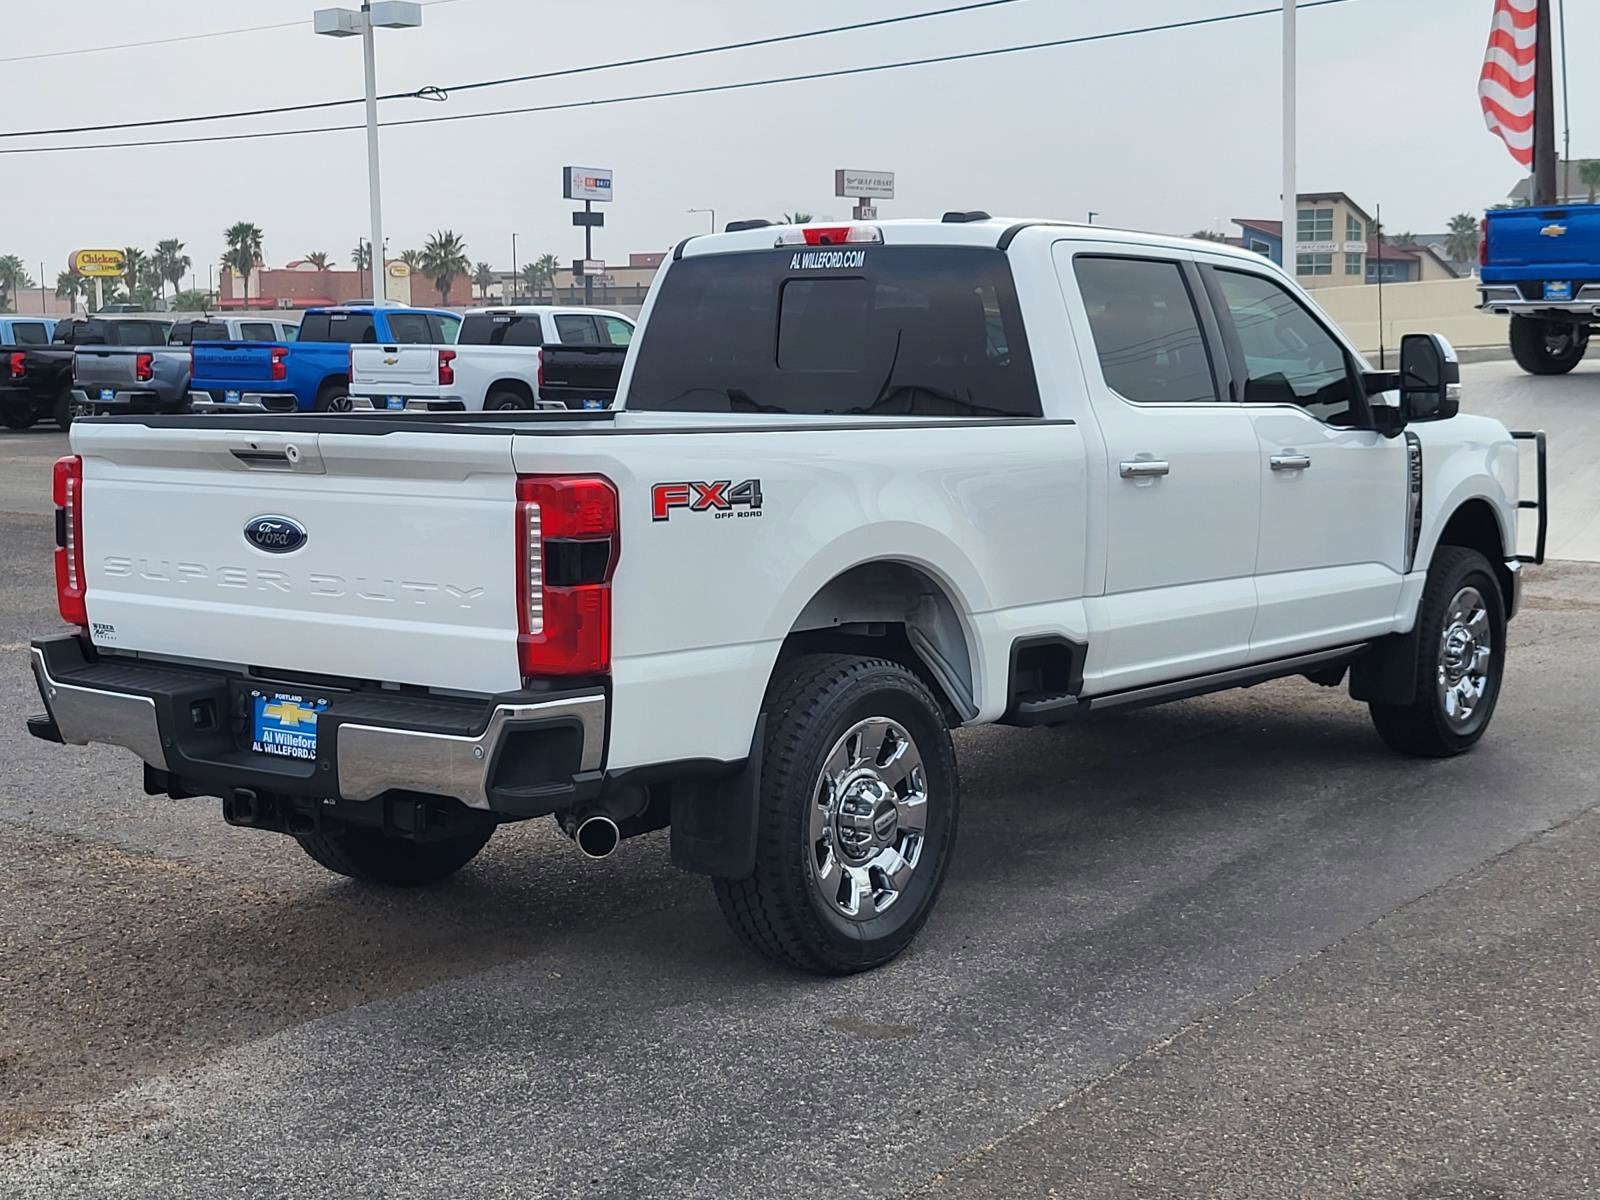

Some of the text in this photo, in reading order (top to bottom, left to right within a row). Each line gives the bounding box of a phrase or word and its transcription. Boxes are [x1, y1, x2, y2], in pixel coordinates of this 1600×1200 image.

[81, 254, 119, 264] Chicken
[790, 251, 865, 269] AL WILLEFORD.COM
[651, 479, 763, 522] FX4
[256, 522, 290, 545] Ford
[104, 555, 486, 609] SUPER DUTY
[275, 693, 303, 702] PORTLAND
[263, 731, 273, 742] Al
[252, 741, 263, 752] AL
